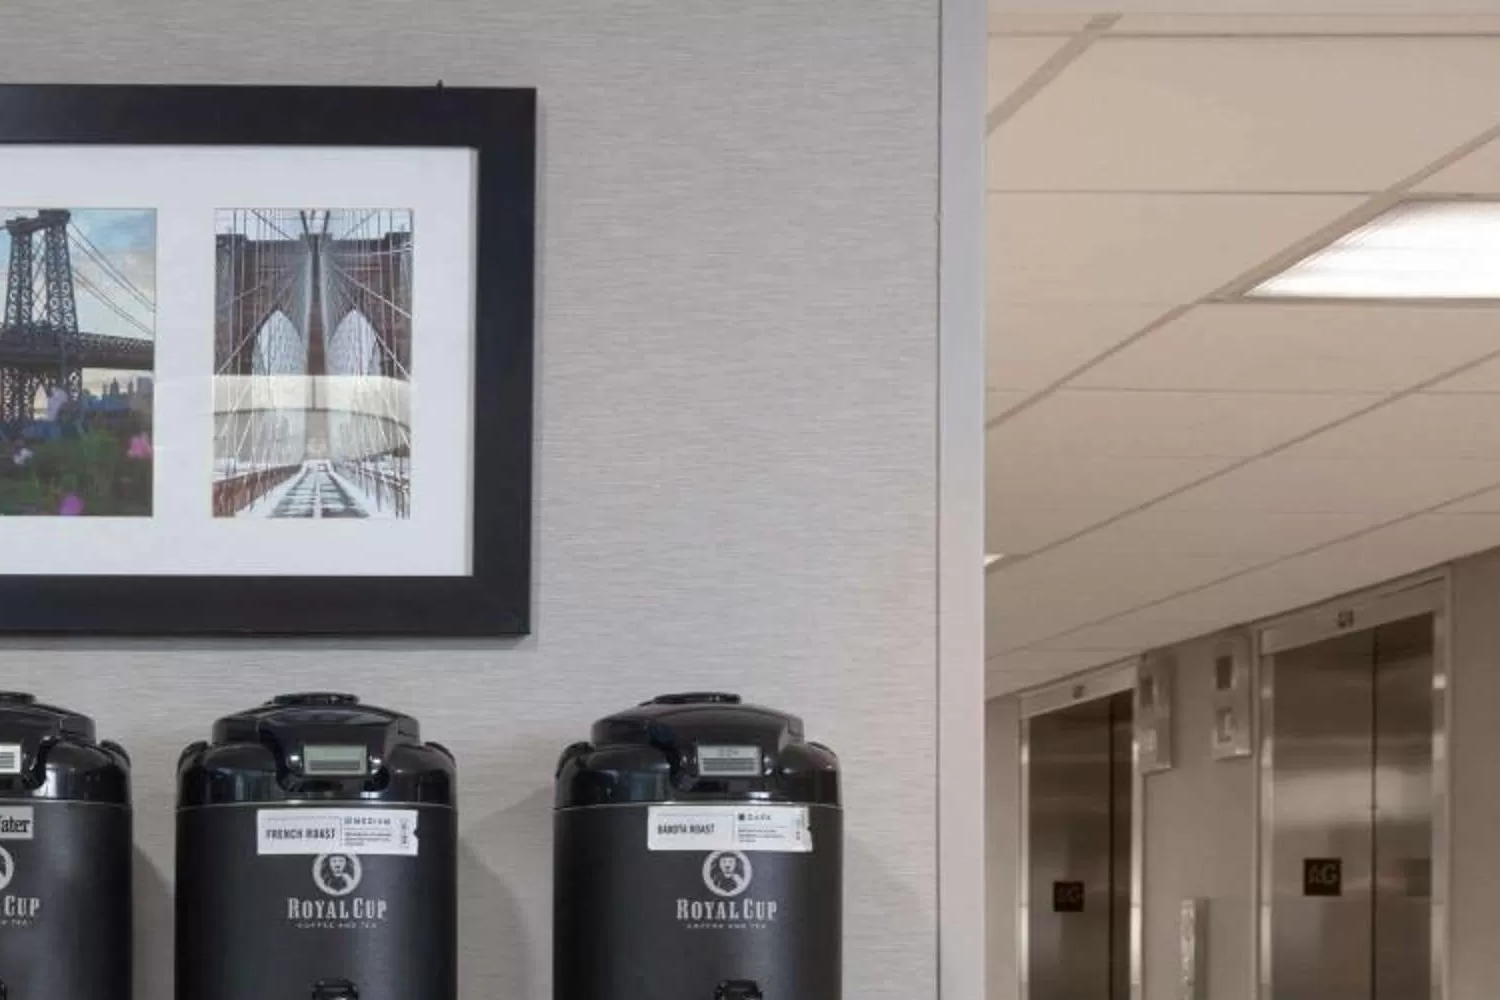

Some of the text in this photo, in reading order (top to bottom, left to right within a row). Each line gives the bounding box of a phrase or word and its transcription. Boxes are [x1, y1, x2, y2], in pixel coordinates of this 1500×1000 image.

[266, 828, 303, 840] FRENCH
[305, 828, 336, 840] ROAST
[4, 896, 40, 917] CUP
[288, 898, 387, 919] ROYAL CUP
[676, 899, 777, 921] ROYAL CUP
